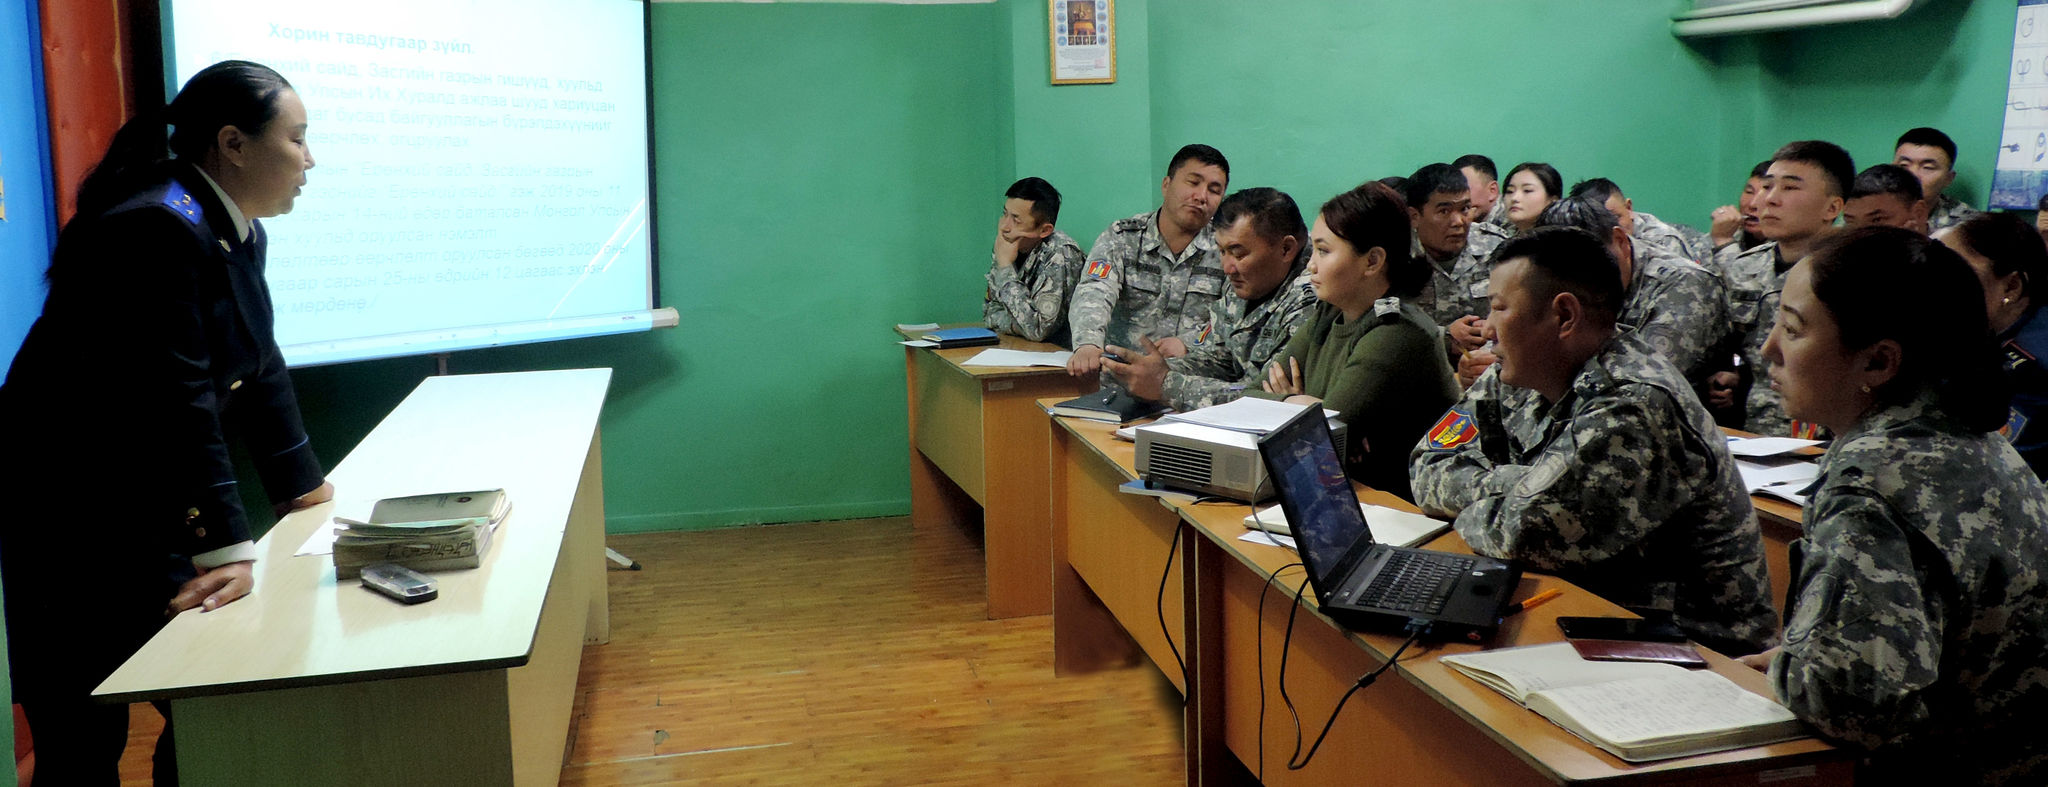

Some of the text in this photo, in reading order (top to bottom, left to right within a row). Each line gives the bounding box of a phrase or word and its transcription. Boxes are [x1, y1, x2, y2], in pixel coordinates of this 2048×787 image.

[268, 22, 475, 55] Хорин тавдугаар зүйл.
[368, 62, 435, 81] Засгийн
[440, 69, 493, 86] газрын
[556, 77, 604, 93] хуульд
[308, 82, 363, 99] Улсын
[368, 85, 391, 101] Их
[396, 87, 455, 105] Хуралд
[553, 97, 616, 114] хариуцан
[336, 107, 386, 124] бусад
[390, 109, 498, 128] байгууллагын
[539, 183, 573, 198] 2019
[534, 203, 585, 217] Монгол
[442, 248, 511, 265] оруулсан
[568, 241, 600, 256] 2020
[323, 274, 377, 292] сарын
[383, 269, 430, 286] 25-ны
[434, 267, 489, 285] өдрийн
[496, 266, 513, 281] 12
[515, 264, 564, 280] цагаас
